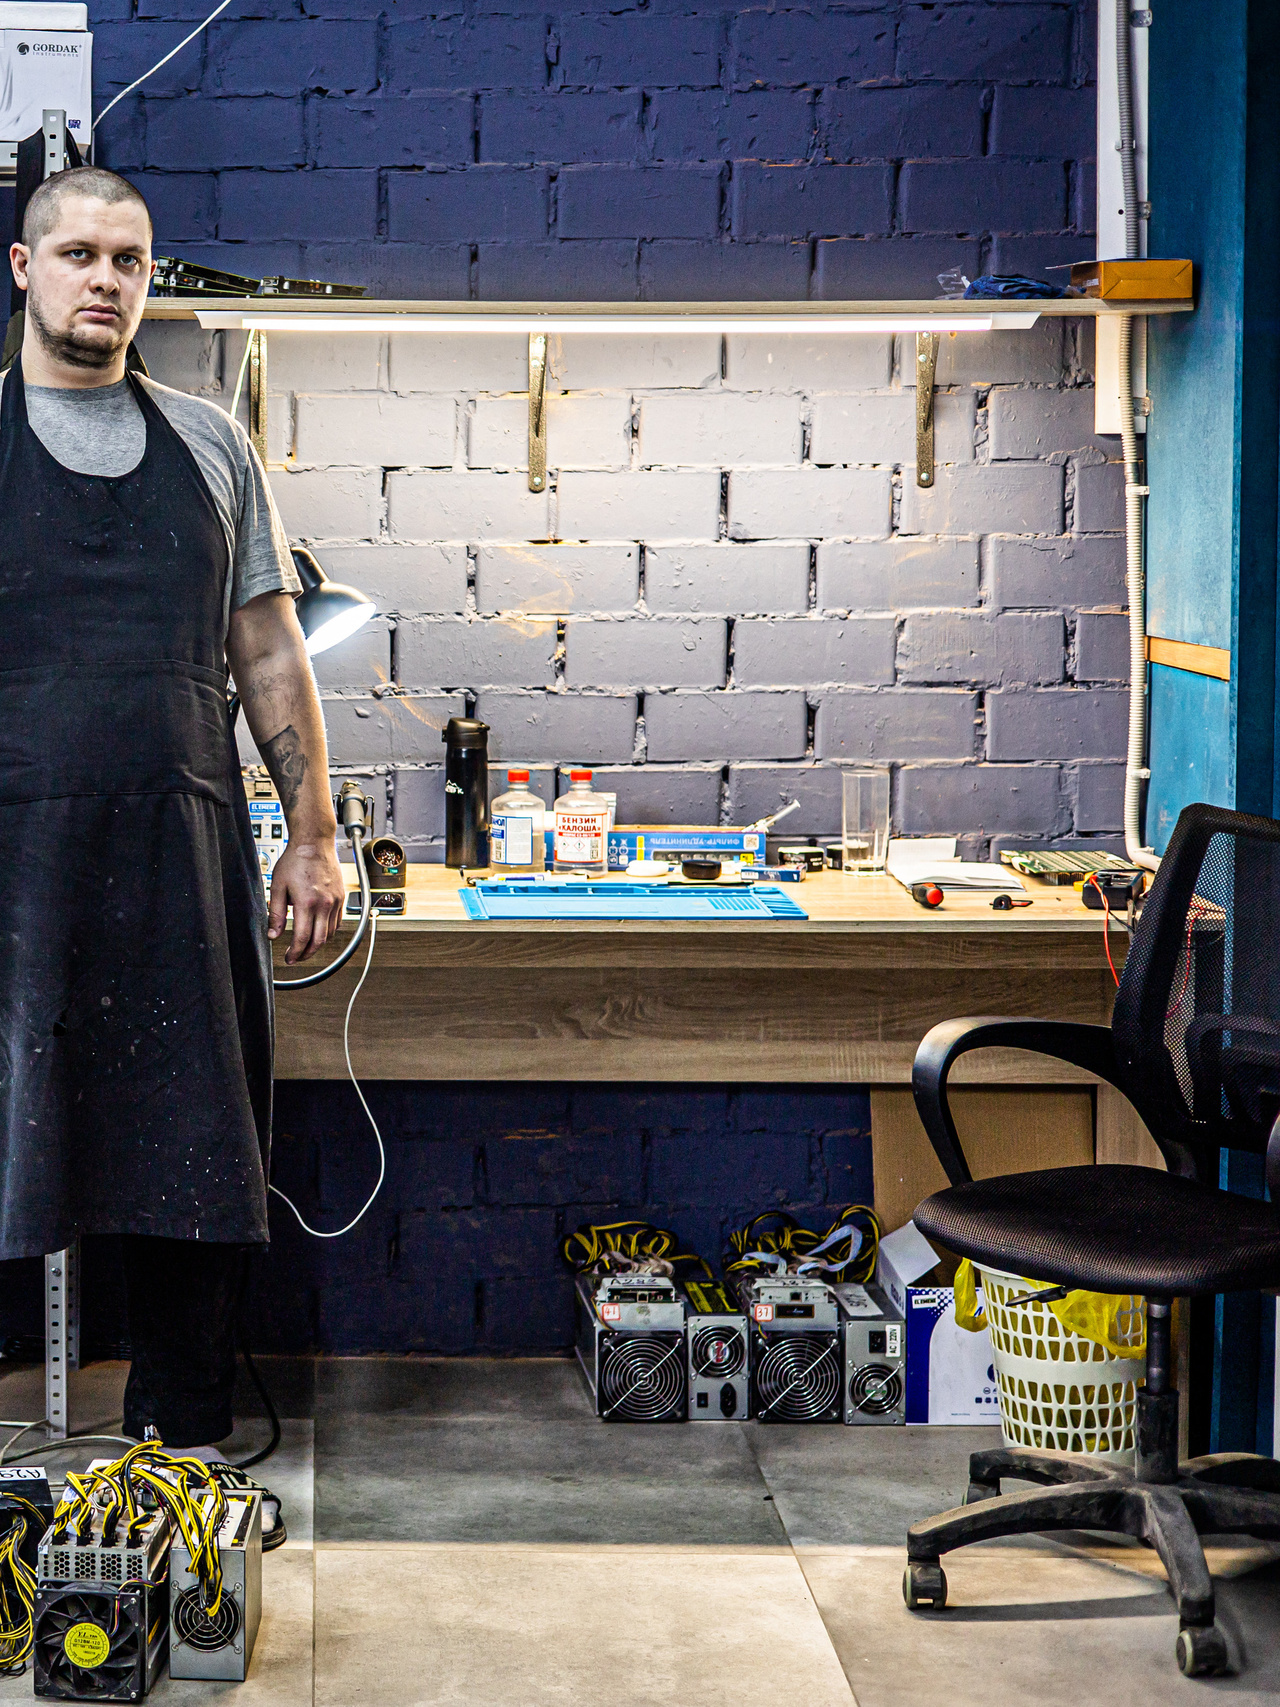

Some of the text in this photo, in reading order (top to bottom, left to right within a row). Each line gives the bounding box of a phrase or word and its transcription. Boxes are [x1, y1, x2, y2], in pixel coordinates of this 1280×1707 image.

[33, 44, 78, 53] GORDAK
[650, 838, 740, 846] ФИЛЬТР-УДЛИНИТЕЛЬ
[604, 1306, 616, 1316] 41
[757, 1307, 769, 1318] 37
[889, 1328, 897, 1341] 220V
[889, 1346, 897, 1354] AC
